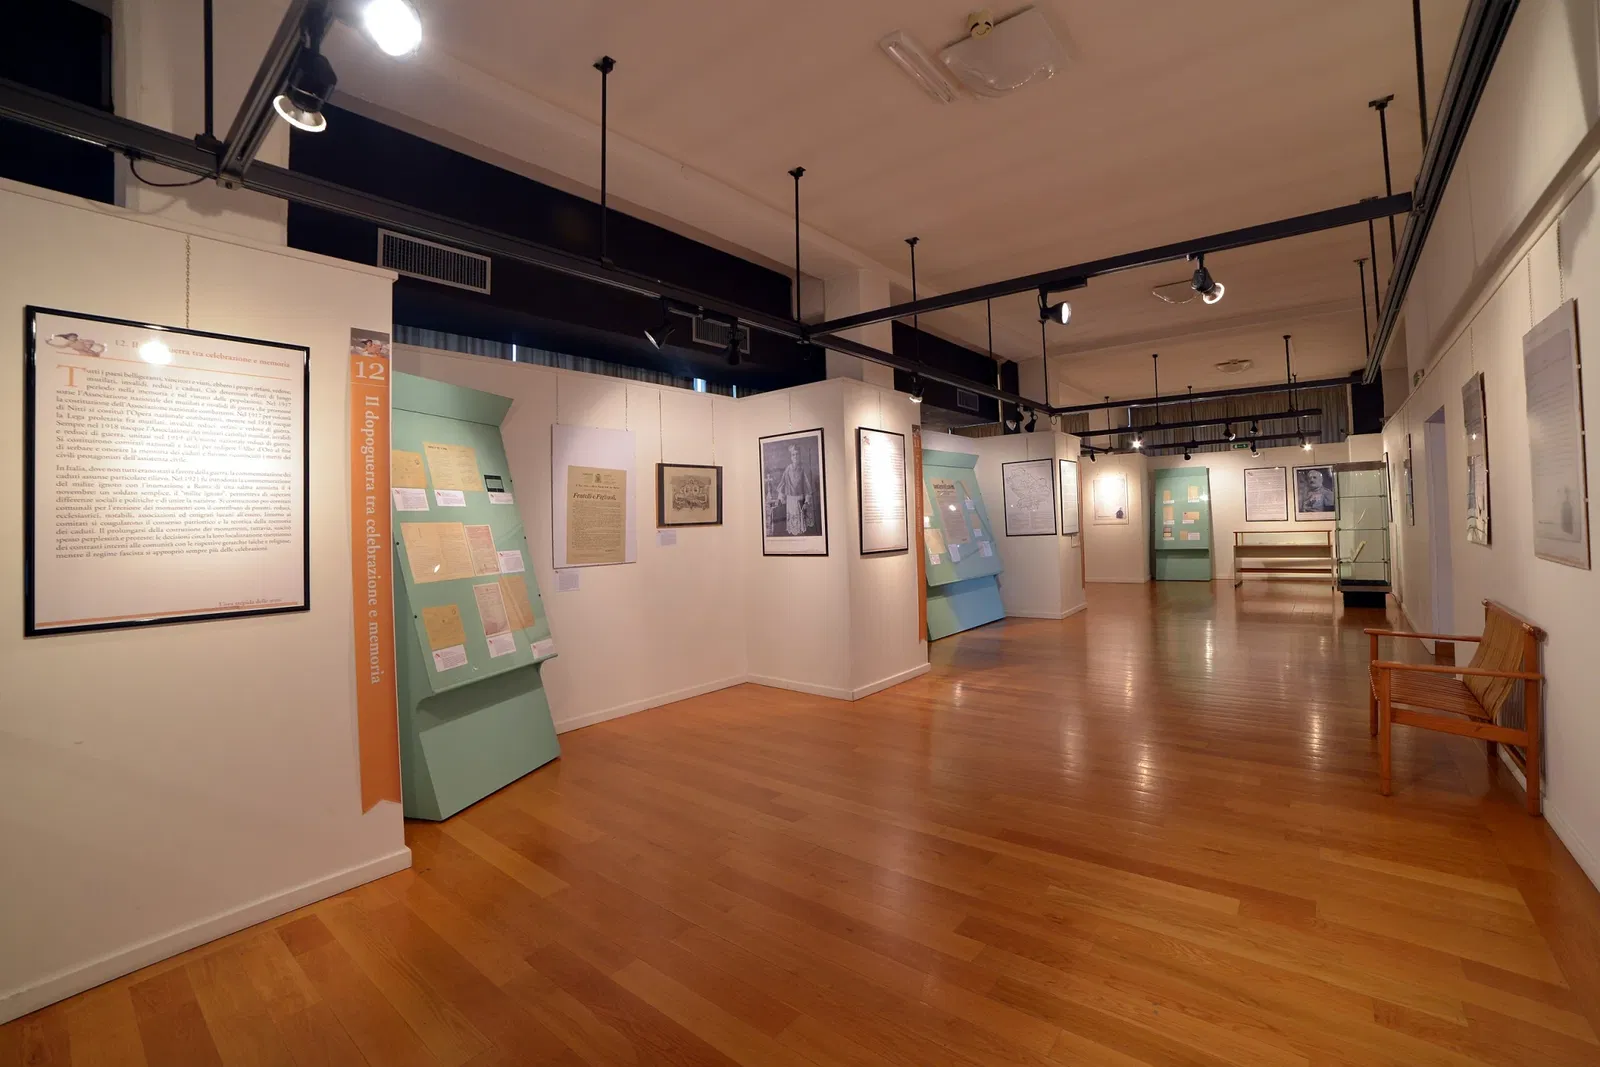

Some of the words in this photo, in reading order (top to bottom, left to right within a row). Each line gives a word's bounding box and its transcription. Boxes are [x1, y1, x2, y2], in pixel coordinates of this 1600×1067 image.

[192, 349, 204, 357] tra
[205, 351, 252, 363] celebrazione
[259, 359, 291, 368] memoria
[355, 361, 385, 381] 12
[86, 383, 115, 393] periodo
[365, 395, 380, 406] Il
[56, 420, 85, 429] Sempre
[68, 413, 84, 421] Lega
[360, 410, 380, 491] dopoguerra
[365, 495, 376, 515] tra
[366, 519, 382, 605] celebrazione
[368, 610, 378, 618] e
[368, 621, 385, 685] memoria
